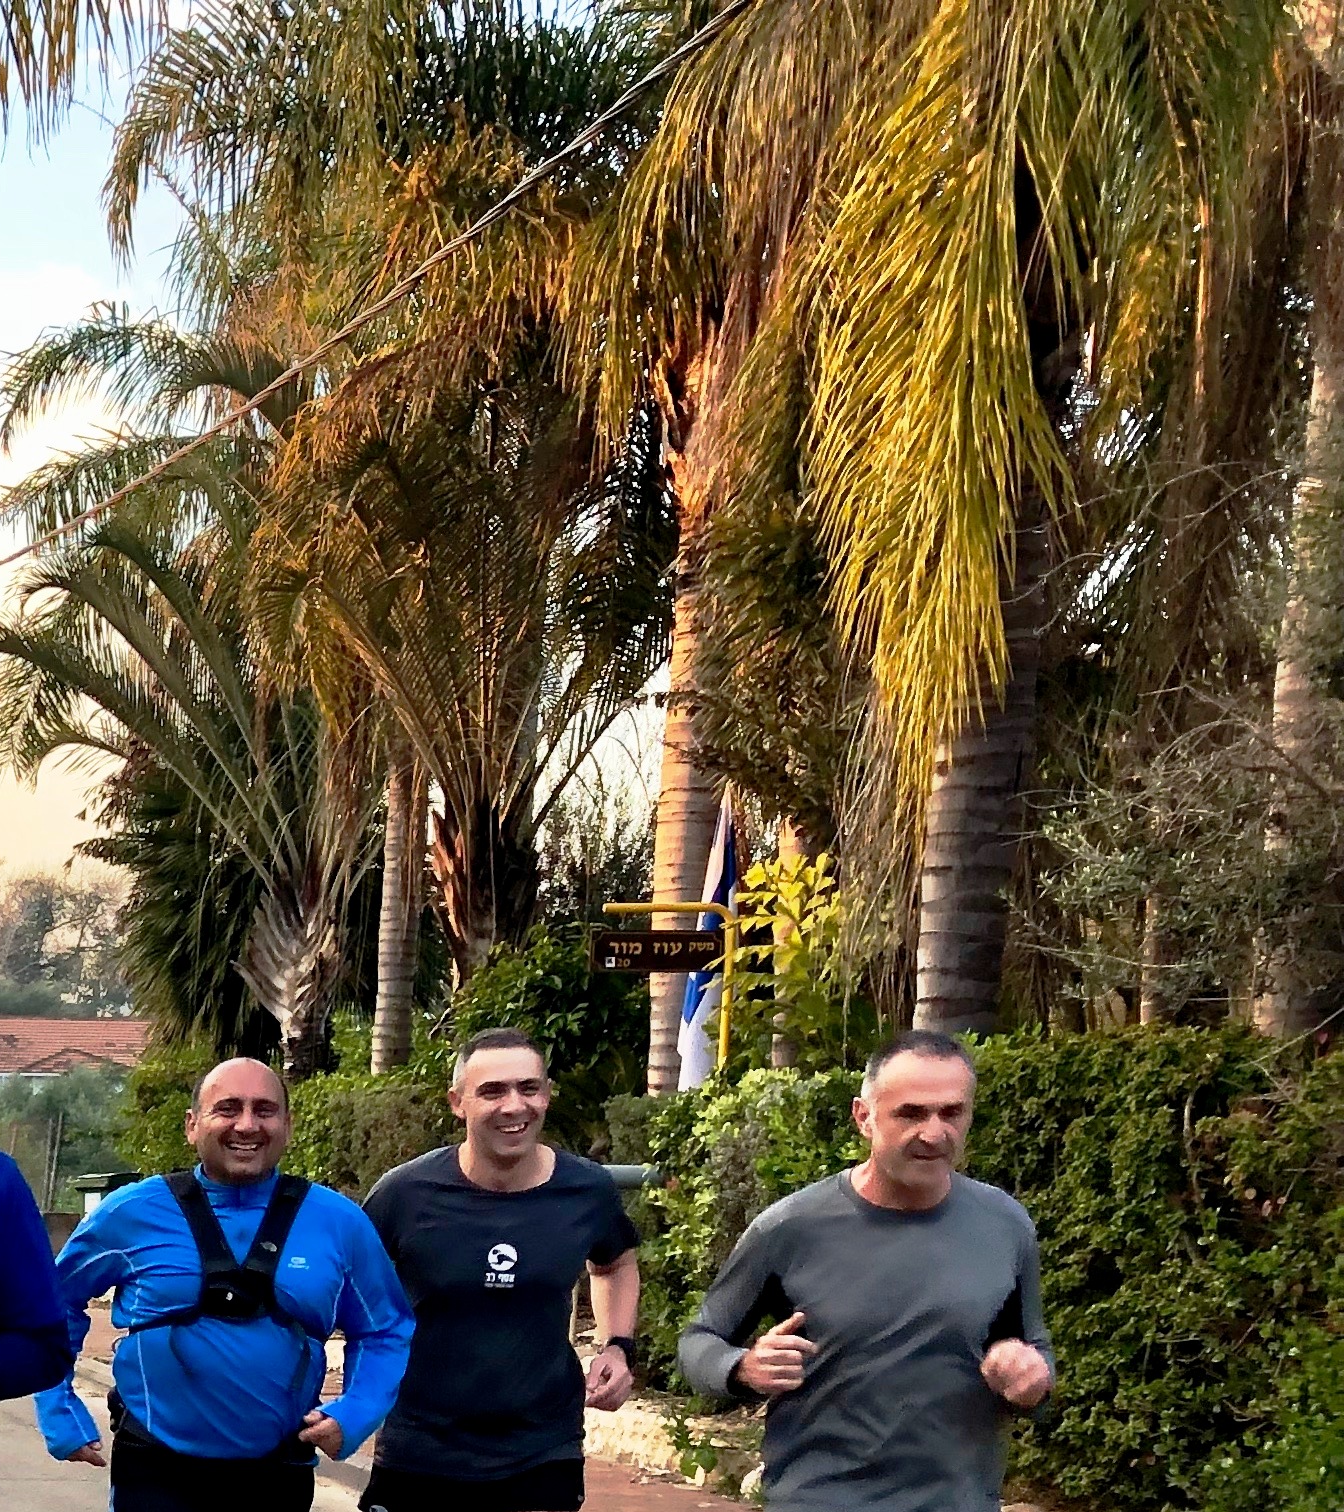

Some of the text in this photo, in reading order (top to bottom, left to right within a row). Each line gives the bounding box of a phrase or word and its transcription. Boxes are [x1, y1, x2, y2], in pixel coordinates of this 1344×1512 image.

[653, 942, 682, 956] עוז
[688, 942, 715, 952] משק
[617, 958, 631, 967] 20
